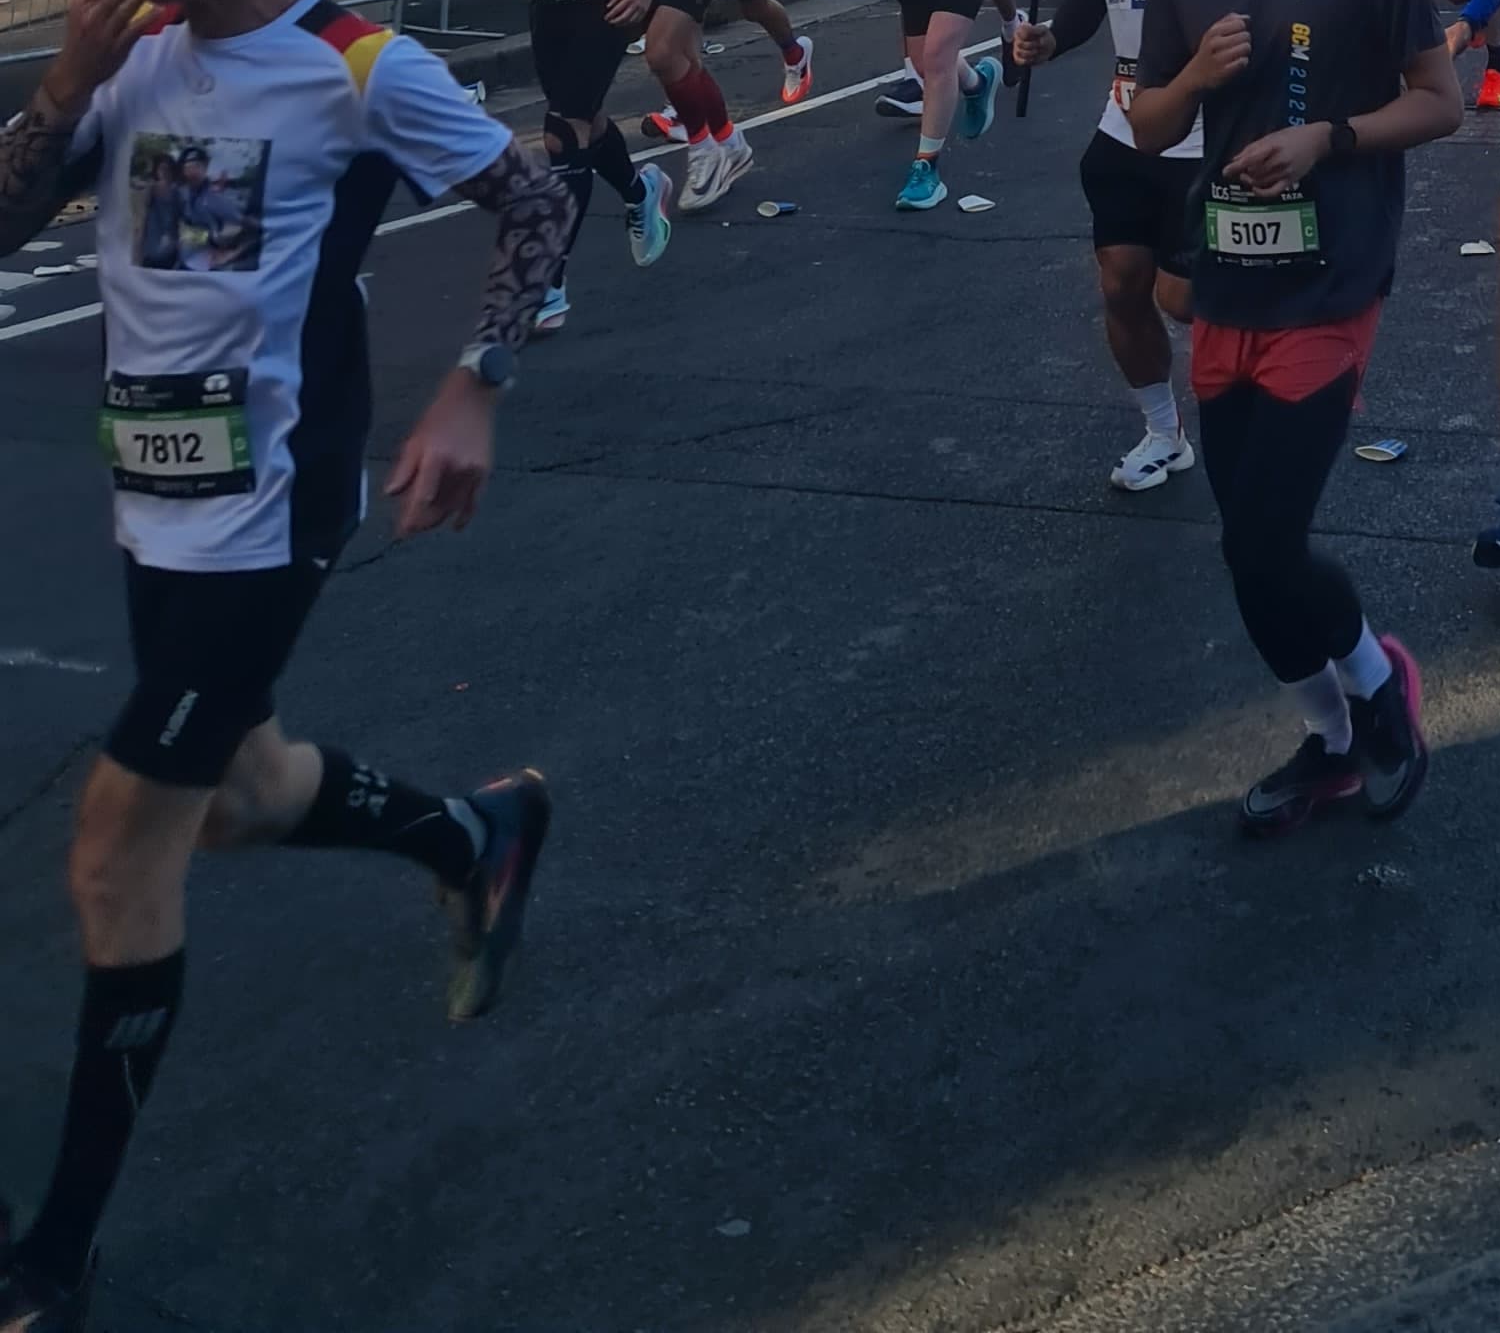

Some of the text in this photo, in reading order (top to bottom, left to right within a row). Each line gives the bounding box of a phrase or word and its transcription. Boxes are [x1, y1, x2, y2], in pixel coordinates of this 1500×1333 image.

[1288, 22, 1312, 127] GCM 2025
[1231, 221, 1281, 246] 5107
[134, 433, 204, 464] 7812
